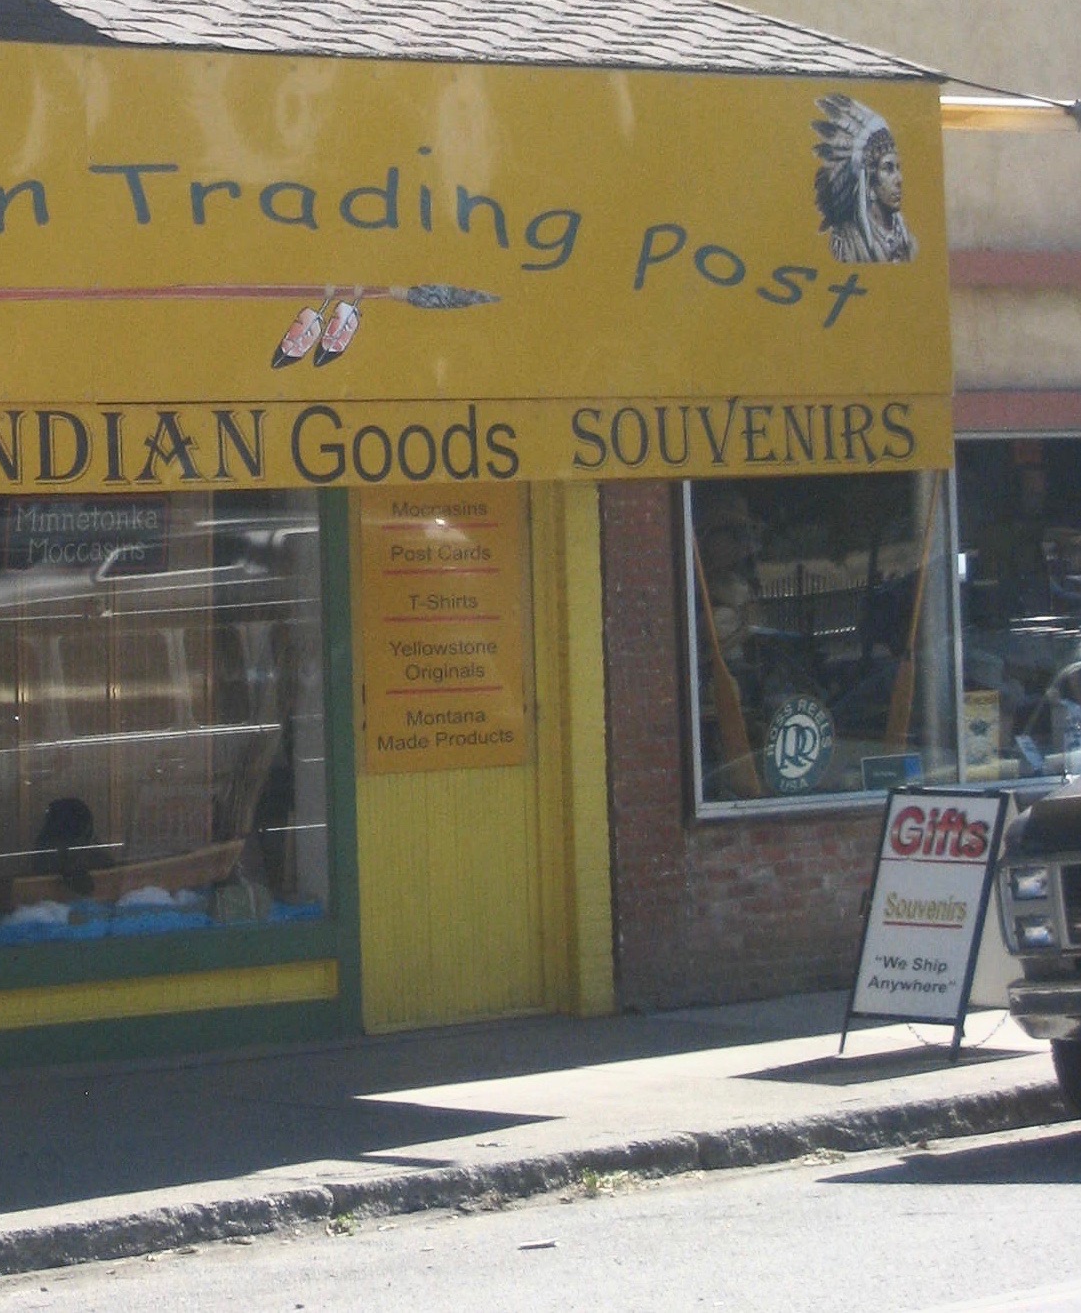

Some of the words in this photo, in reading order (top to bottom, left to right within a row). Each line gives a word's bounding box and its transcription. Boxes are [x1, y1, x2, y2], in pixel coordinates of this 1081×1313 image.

[88, 145, 582, 273] Trading
[571, 397, 917, 471] SOUVENIRS
[290, 403, 520, 492] Goods
[15, 504, 160, 533] Minnetonka
[392, 501, 487, 518] Moccasins
[26, 538, 147, 564] Moccasins
[391, 545, 432, 562] Post
[438, 544, 491, 562] Cards
[409, 594, 478, 611] T-Shirts
[389, 640, 497, 658] Yellowstone
[405, 663, 485, 682] Originals
[407, 709, 486, 726] Montana
[377, 735, 429, 752] Made
[435, 728, 514, 747] Products
[890, 806, 989, 858] Gifts
[883, 892, 967, 922] Souvenirs
[912, 957, 948, 974] Ship
